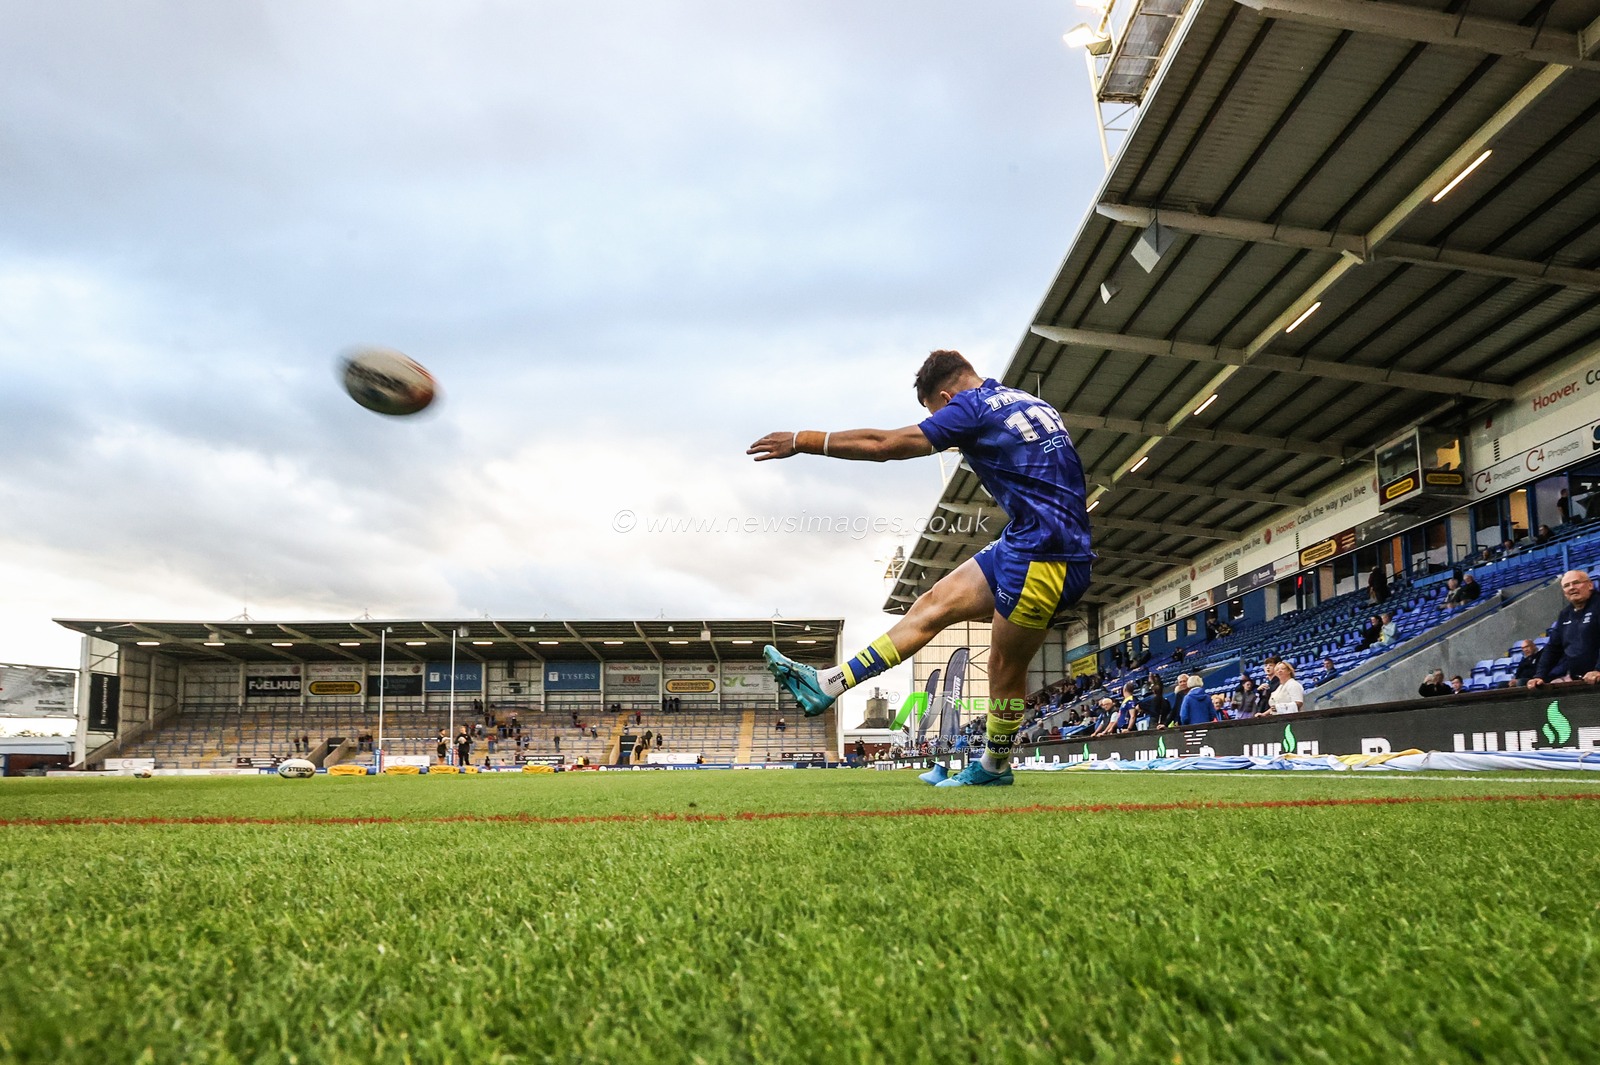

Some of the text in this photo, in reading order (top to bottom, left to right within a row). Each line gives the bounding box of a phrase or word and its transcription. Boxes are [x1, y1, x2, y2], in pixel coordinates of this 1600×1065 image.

[1532, 381, 1580, 412] Hoover.
[1547, 441, 1580, 459] Projects
[1494, 466, 1521, 482] Projects
[1297, 511, 1312, 525] Cook
[1313, 505, 1325, 518] the
[1325, 499, 1339, 512] way
[1339, 492, 1353, 507] you
[1353, 485, 1367, 498] live
[248, 680, 301, 690] FUELHUB
